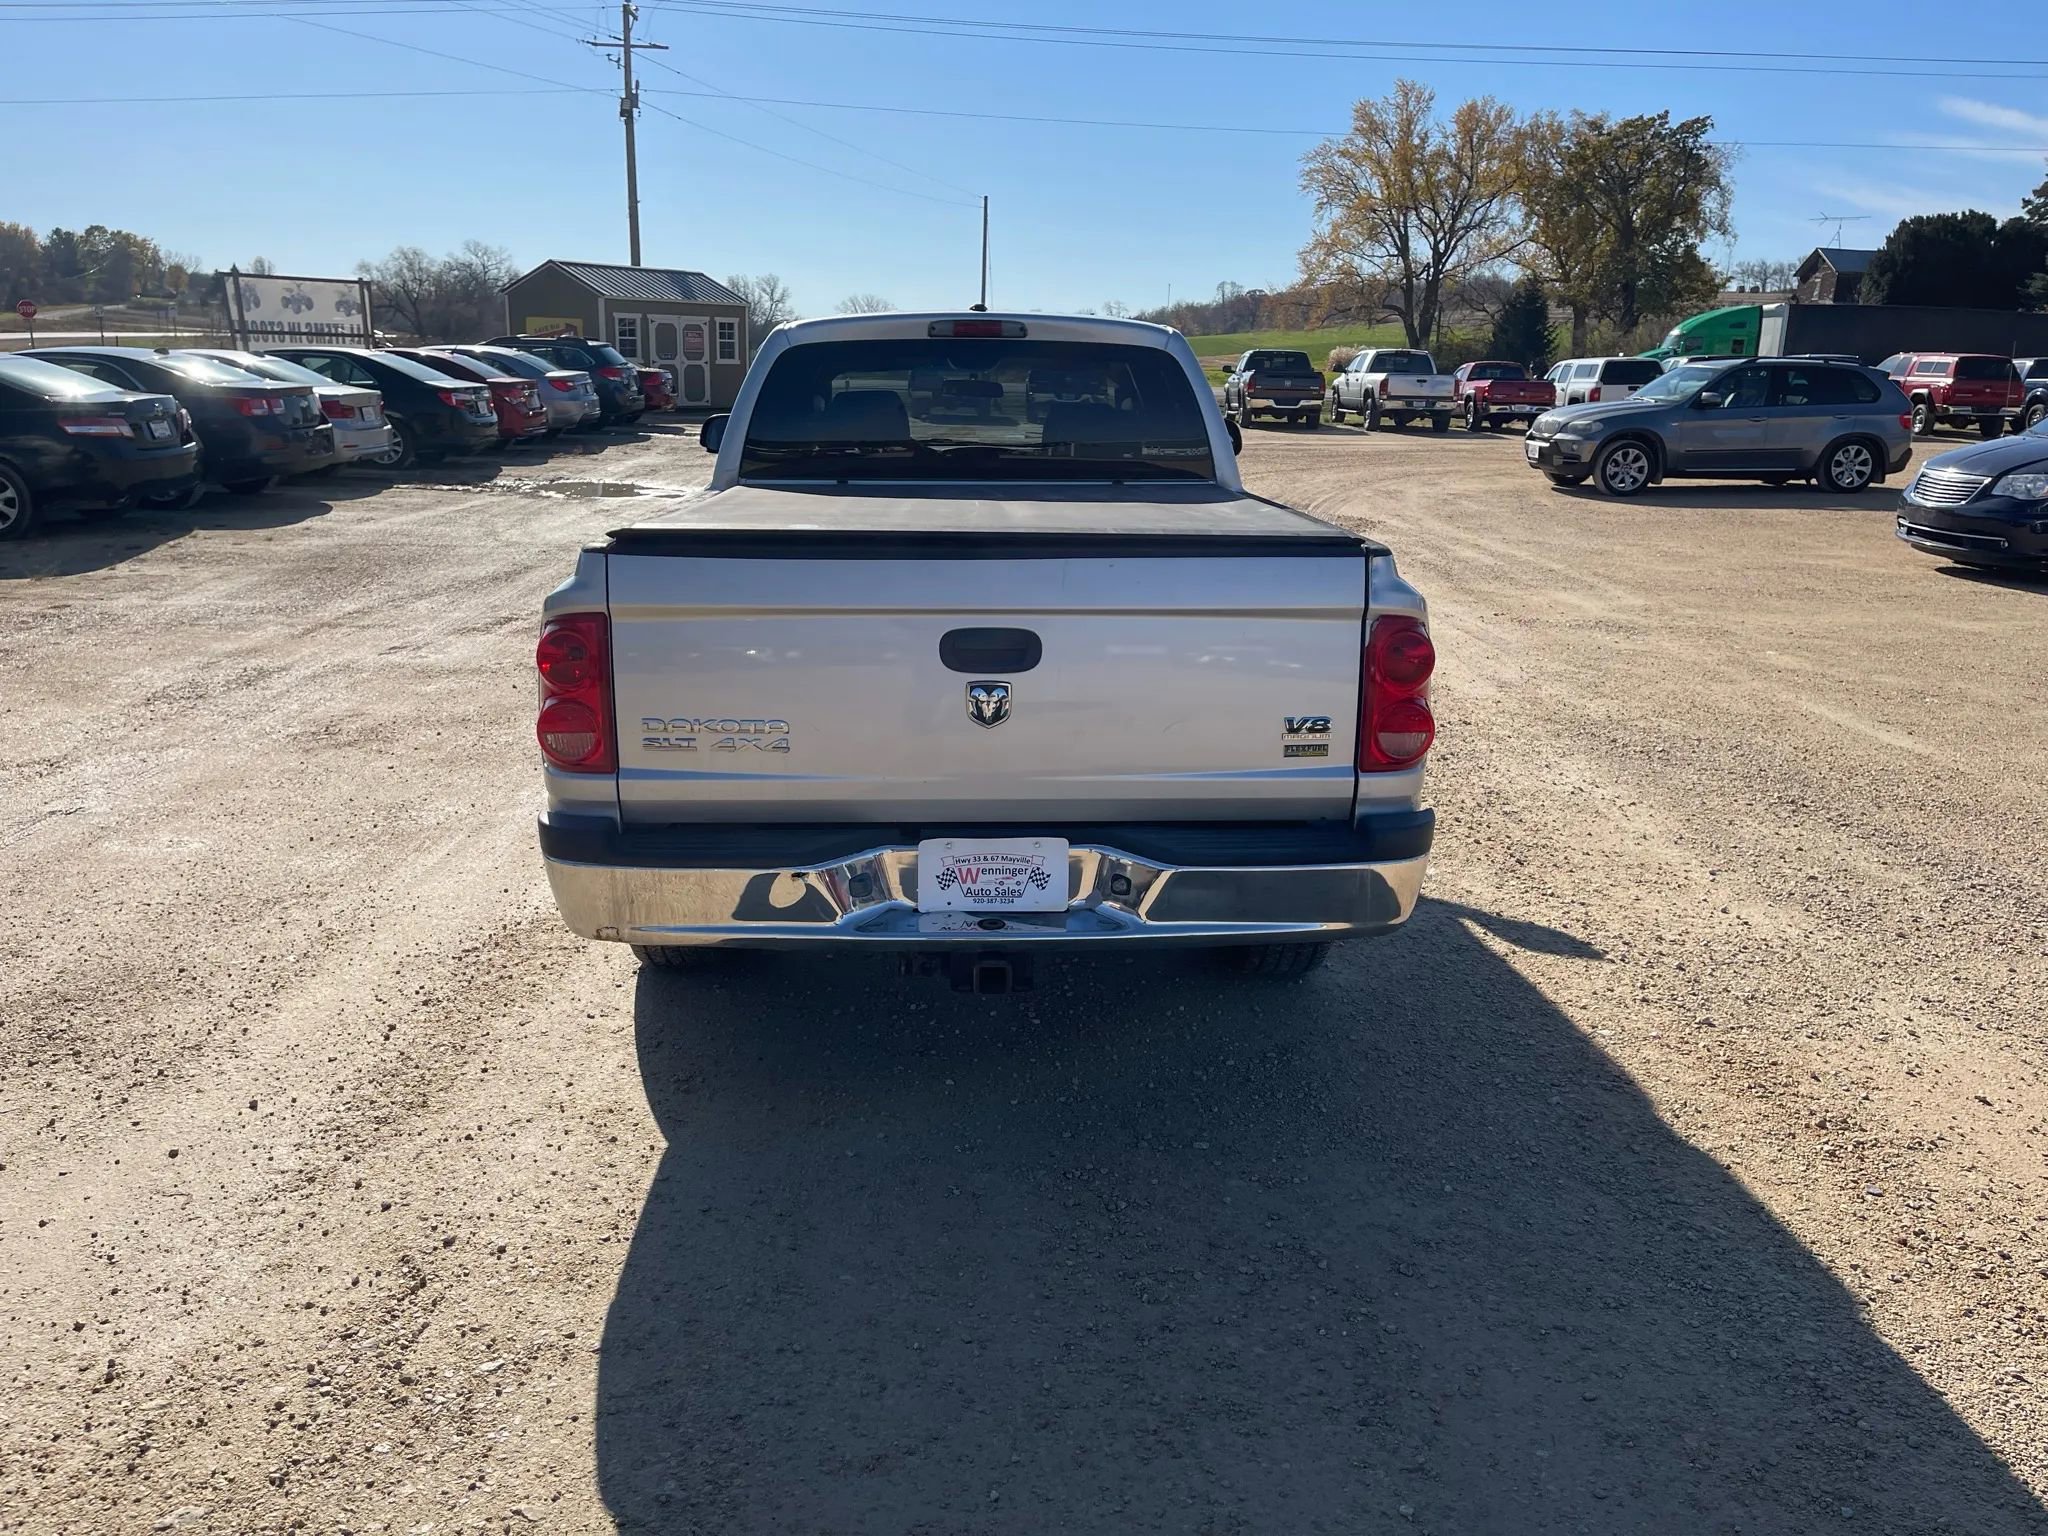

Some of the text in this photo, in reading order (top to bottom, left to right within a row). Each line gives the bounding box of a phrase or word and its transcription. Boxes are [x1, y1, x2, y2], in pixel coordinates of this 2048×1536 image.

[19, 305, 36, 313] STOP
[641, 718, 790, 734] DAKOTA
[1283, 715, 1332, 733] V8
[642, 737, 790, 753] SLT 4X4
[1001, 855, 1031, 865] Mayville
[957, 866, 1029, 885] Wenninger
[965, 886, 1022, 896] Auto Sales
